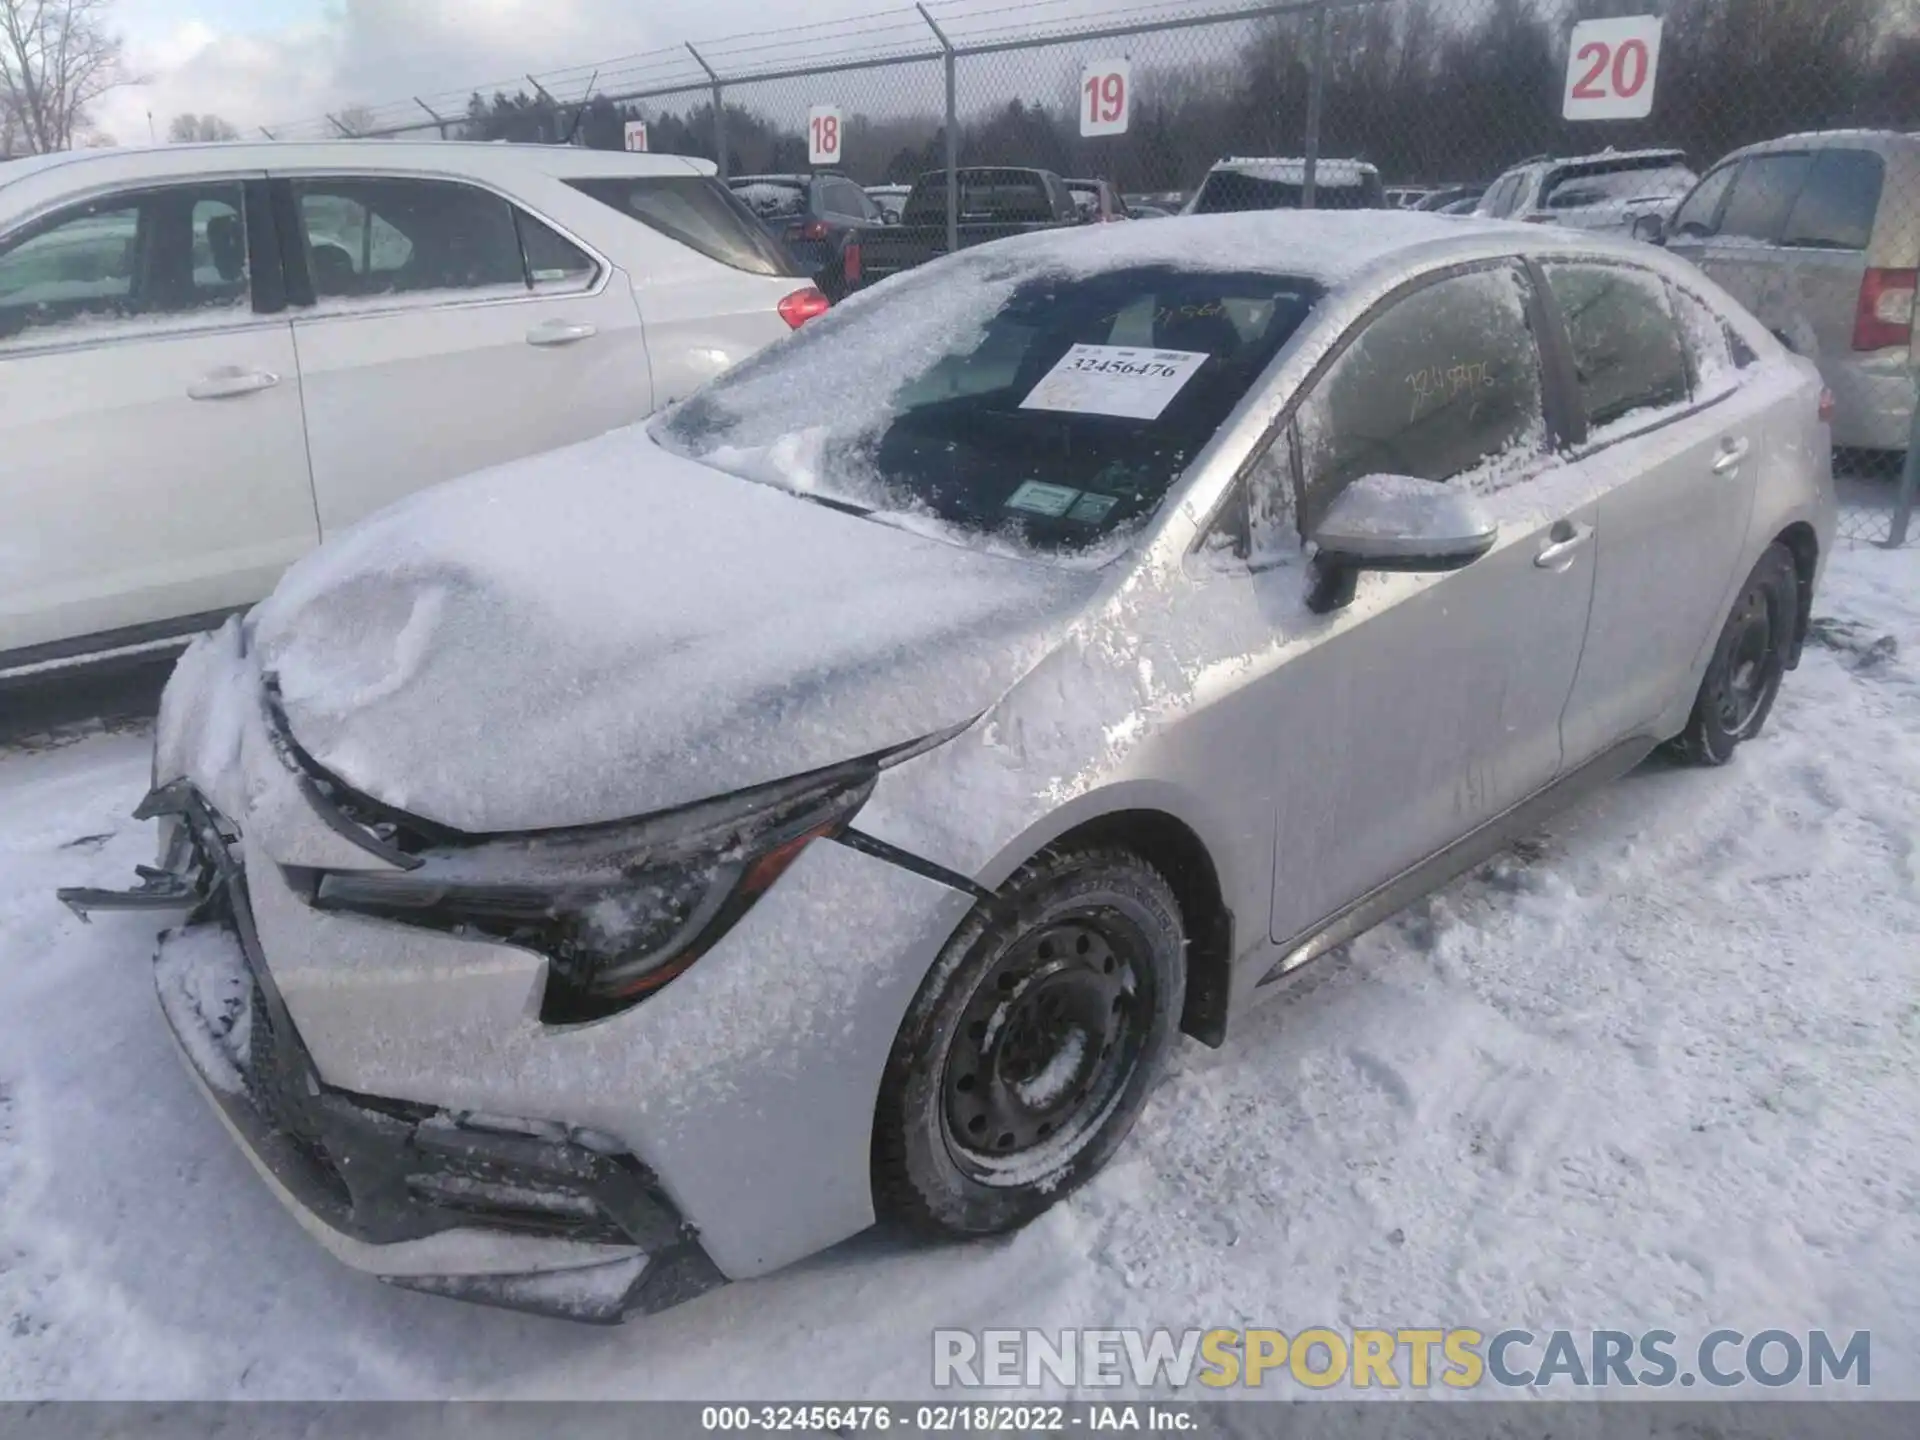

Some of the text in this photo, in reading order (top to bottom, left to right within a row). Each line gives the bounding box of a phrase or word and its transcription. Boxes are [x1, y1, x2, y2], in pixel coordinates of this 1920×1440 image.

[1572, 39, 1648, 98] 20
[1085, 73, 1124, 122] 19
[812, 115, 837, 154] 18
[1067, 356, 1177, 378] 32456476
